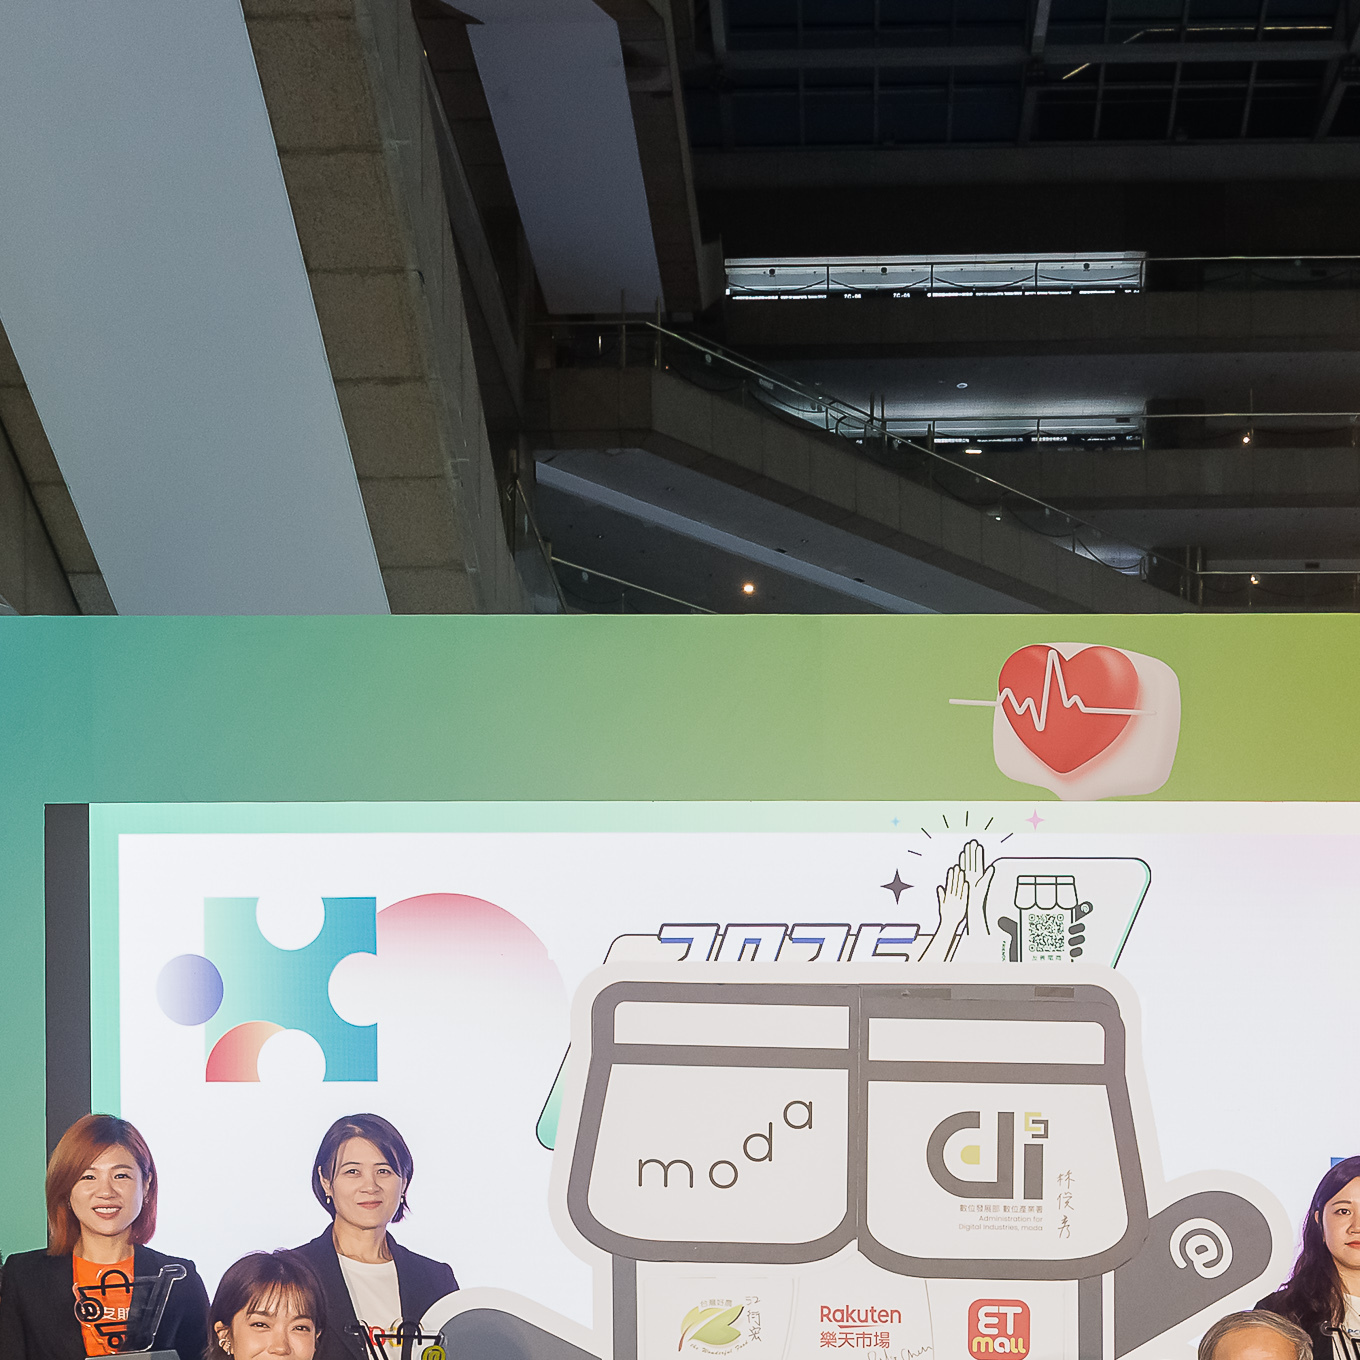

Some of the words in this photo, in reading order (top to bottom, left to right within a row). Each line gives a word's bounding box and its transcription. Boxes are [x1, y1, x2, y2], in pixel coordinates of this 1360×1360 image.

[638, 1100, 813, 1189] moda
[958, 1223, 982, 1231] Digital
[983, 1223, 1020, 1231] Industries,
[978, 1215, 1032, 1223] Administration
[820, 1304, 902, 1324] Rakuten
[977, 1305, 1023, 1336] ET
[819, 1330, 890, 1349] 樂天市場
[972, 1336, 1026, 1354] mall
